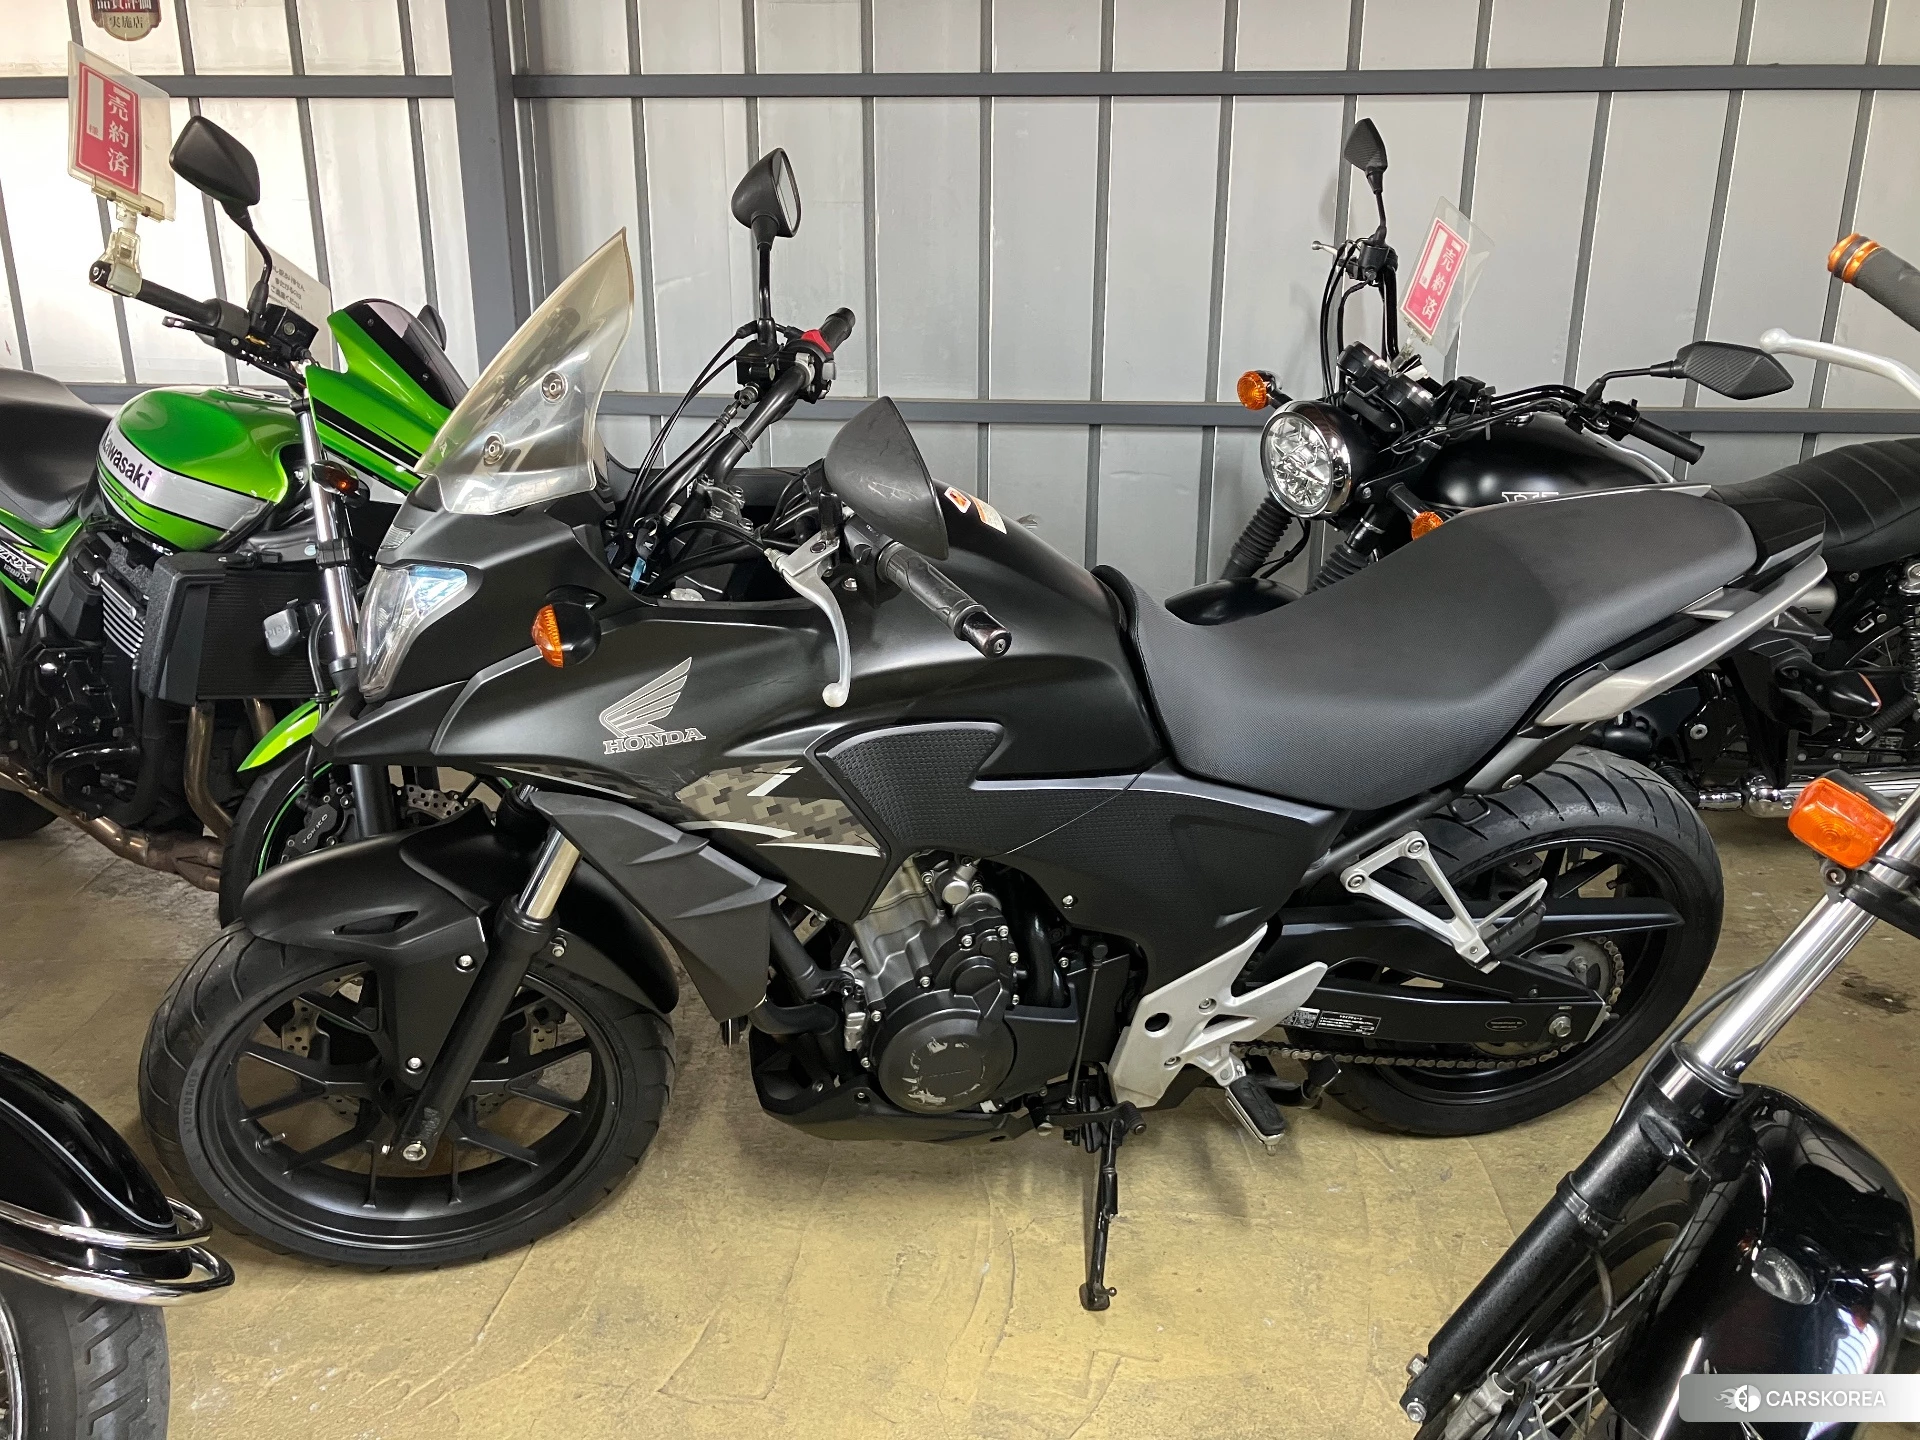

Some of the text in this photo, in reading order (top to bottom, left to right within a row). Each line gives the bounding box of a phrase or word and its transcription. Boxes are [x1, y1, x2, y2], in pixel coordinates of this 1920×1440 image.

[109, 15, 144, 29] 実施店
[107, 93, 130, 177] 売約済
[1421, 246, 1457, 320] 売約済
[603, 727, 707, 755] HONDA
[183, 1068, 200, 1125] DUNLOP
